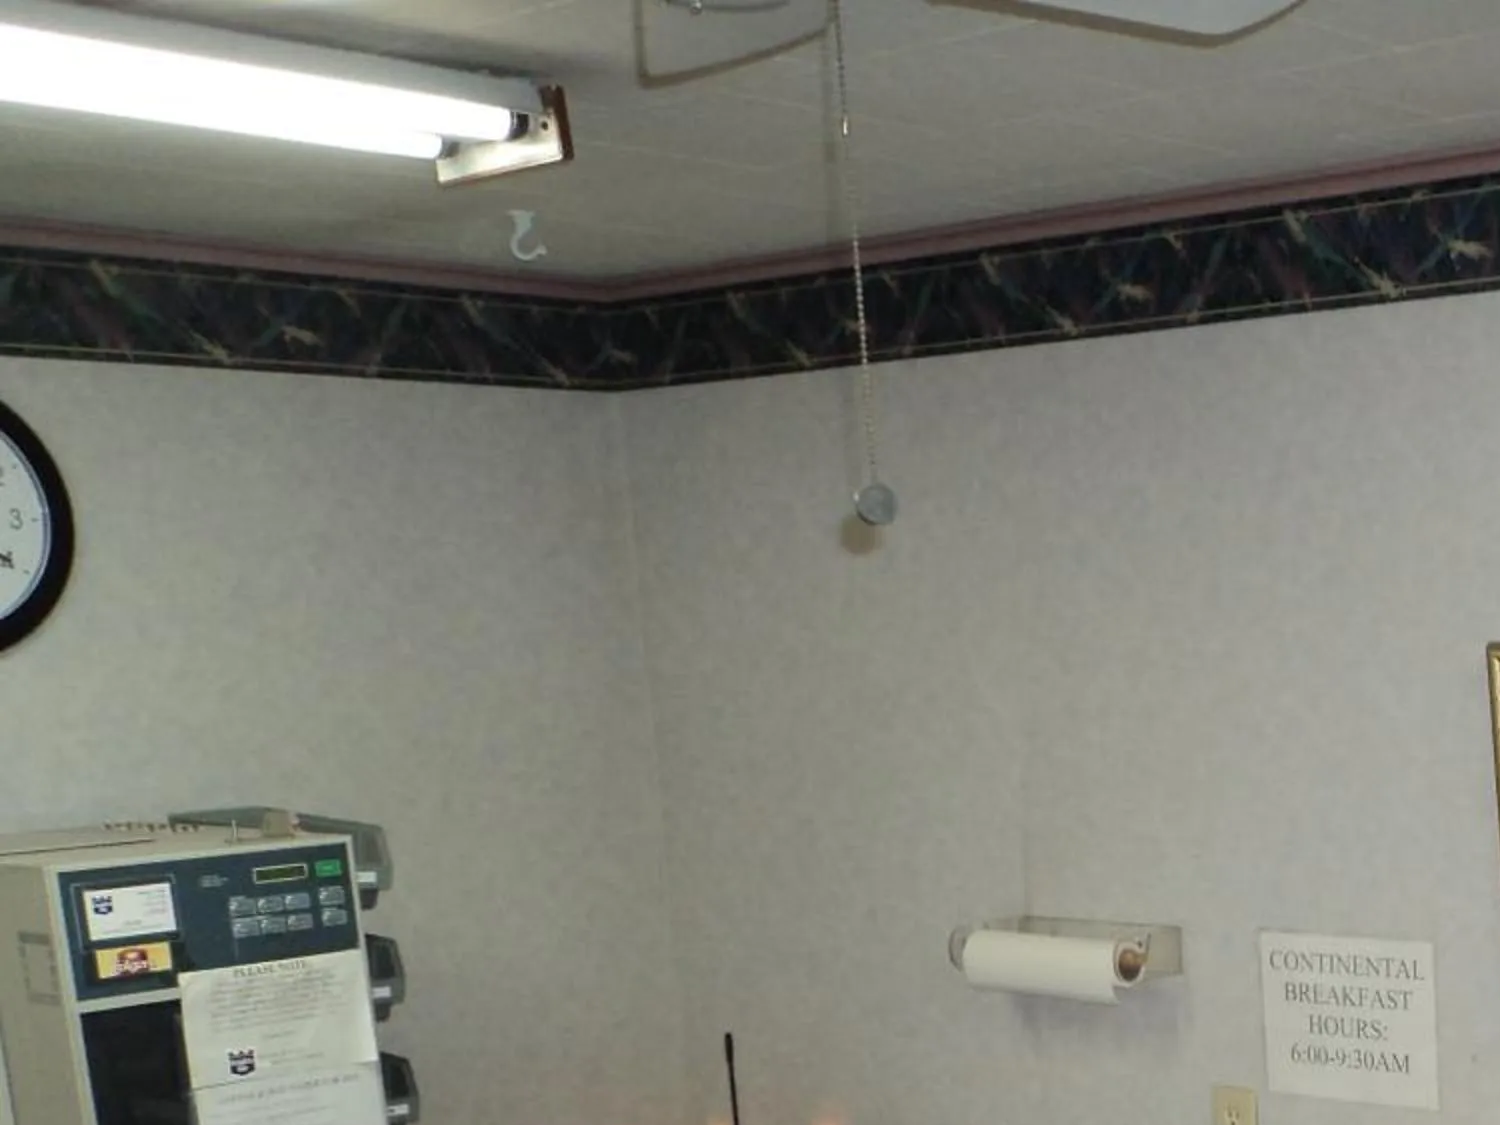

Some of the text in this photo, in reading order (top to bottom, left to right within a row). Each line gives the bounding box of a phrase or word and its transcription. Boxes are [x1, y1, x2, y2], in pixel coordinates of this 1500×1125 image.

[1268, 949, 1426, 982] CONTINENTAL
[1283, 981, 1414, 1012] BREAKFAST
[1308, 1014, 1389, 1042] HOURS:
[1290, 1043, 1411, 1075] 6:00-9:30AM
